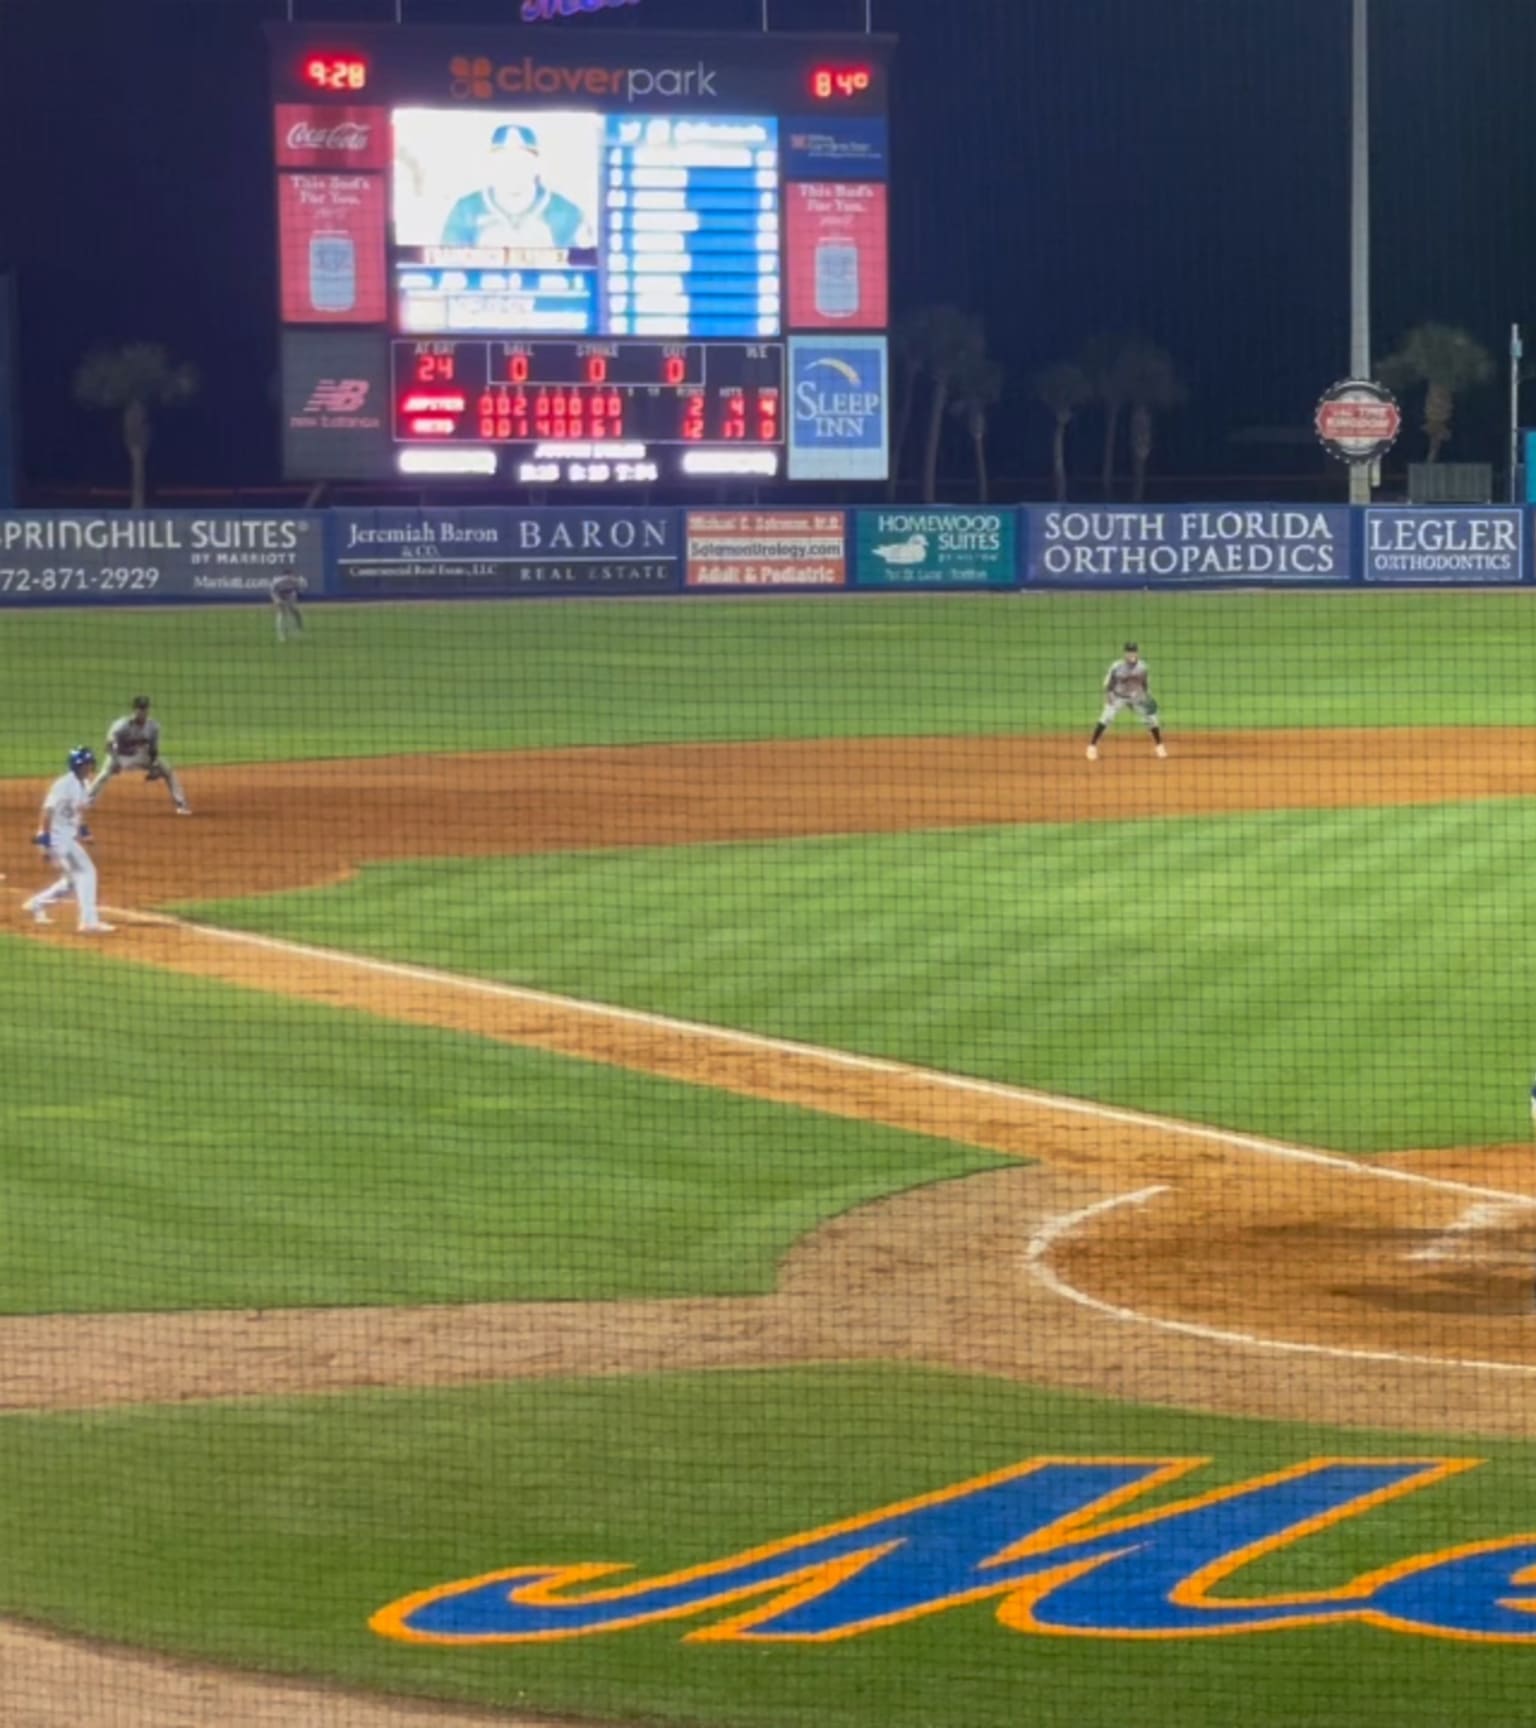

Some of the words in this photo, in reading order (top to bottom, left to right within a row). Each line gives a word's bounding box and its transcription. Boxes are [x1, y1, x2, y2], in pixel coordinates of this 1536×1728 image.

[308, 61, 365, 88] 9:28
[419, 355, 453, 381] 24
[512, 356, 528, 381] 0
[589, 357, 606, 383] 0
[667, 358, 685, 384] 0
[796, 380, 879, 421] SLEEP
[815, 417, 865, 437] INN
[0, 520, 182, 549] PRINGHILL
[190, 520, 297, 548] SUITES
[347, 520, 435, 548] Jeremiah
[440, 521, 499, 542] Baron
[520, 519, 668, 549] BARON
[878, 514, 1001, 533] HOMEWOOD
[1044, 512, 1164, 541] SOUTH
[1180, 511, 1333, 540] FLORIDA
[1370, 519, 1517, 551] LEGLER
[938, 532, 1001, 551] SUITES
[1044, 544, 1333, 574] ORTHOPAEDICS
[1374, 553, 1511, 571] ORTHODONTICS
[520, 566, 576, 581] REAL
[589, 565, 668, 580] ESTATE
[698, 565, 739, 583] Adult
[760, 564, 836, 584] Pediatric
